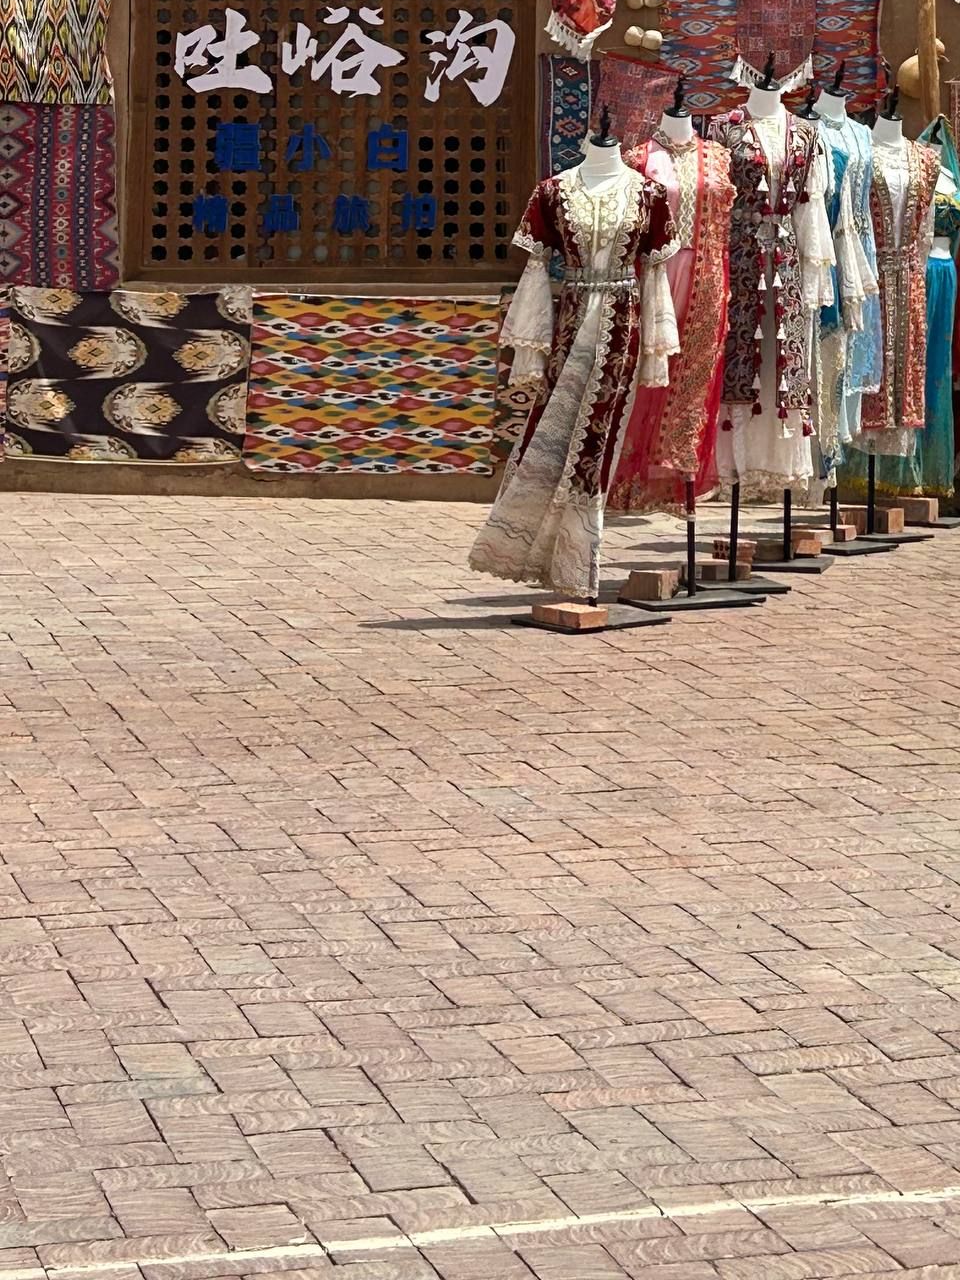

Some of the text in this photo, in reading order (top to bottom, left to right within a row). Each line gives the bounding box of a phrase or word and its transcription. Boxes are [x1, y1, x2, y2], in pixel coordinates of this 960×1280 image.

[173, 7, 516, 107] 吐峪沟
[214, 123, 409, 171] 疆小白
